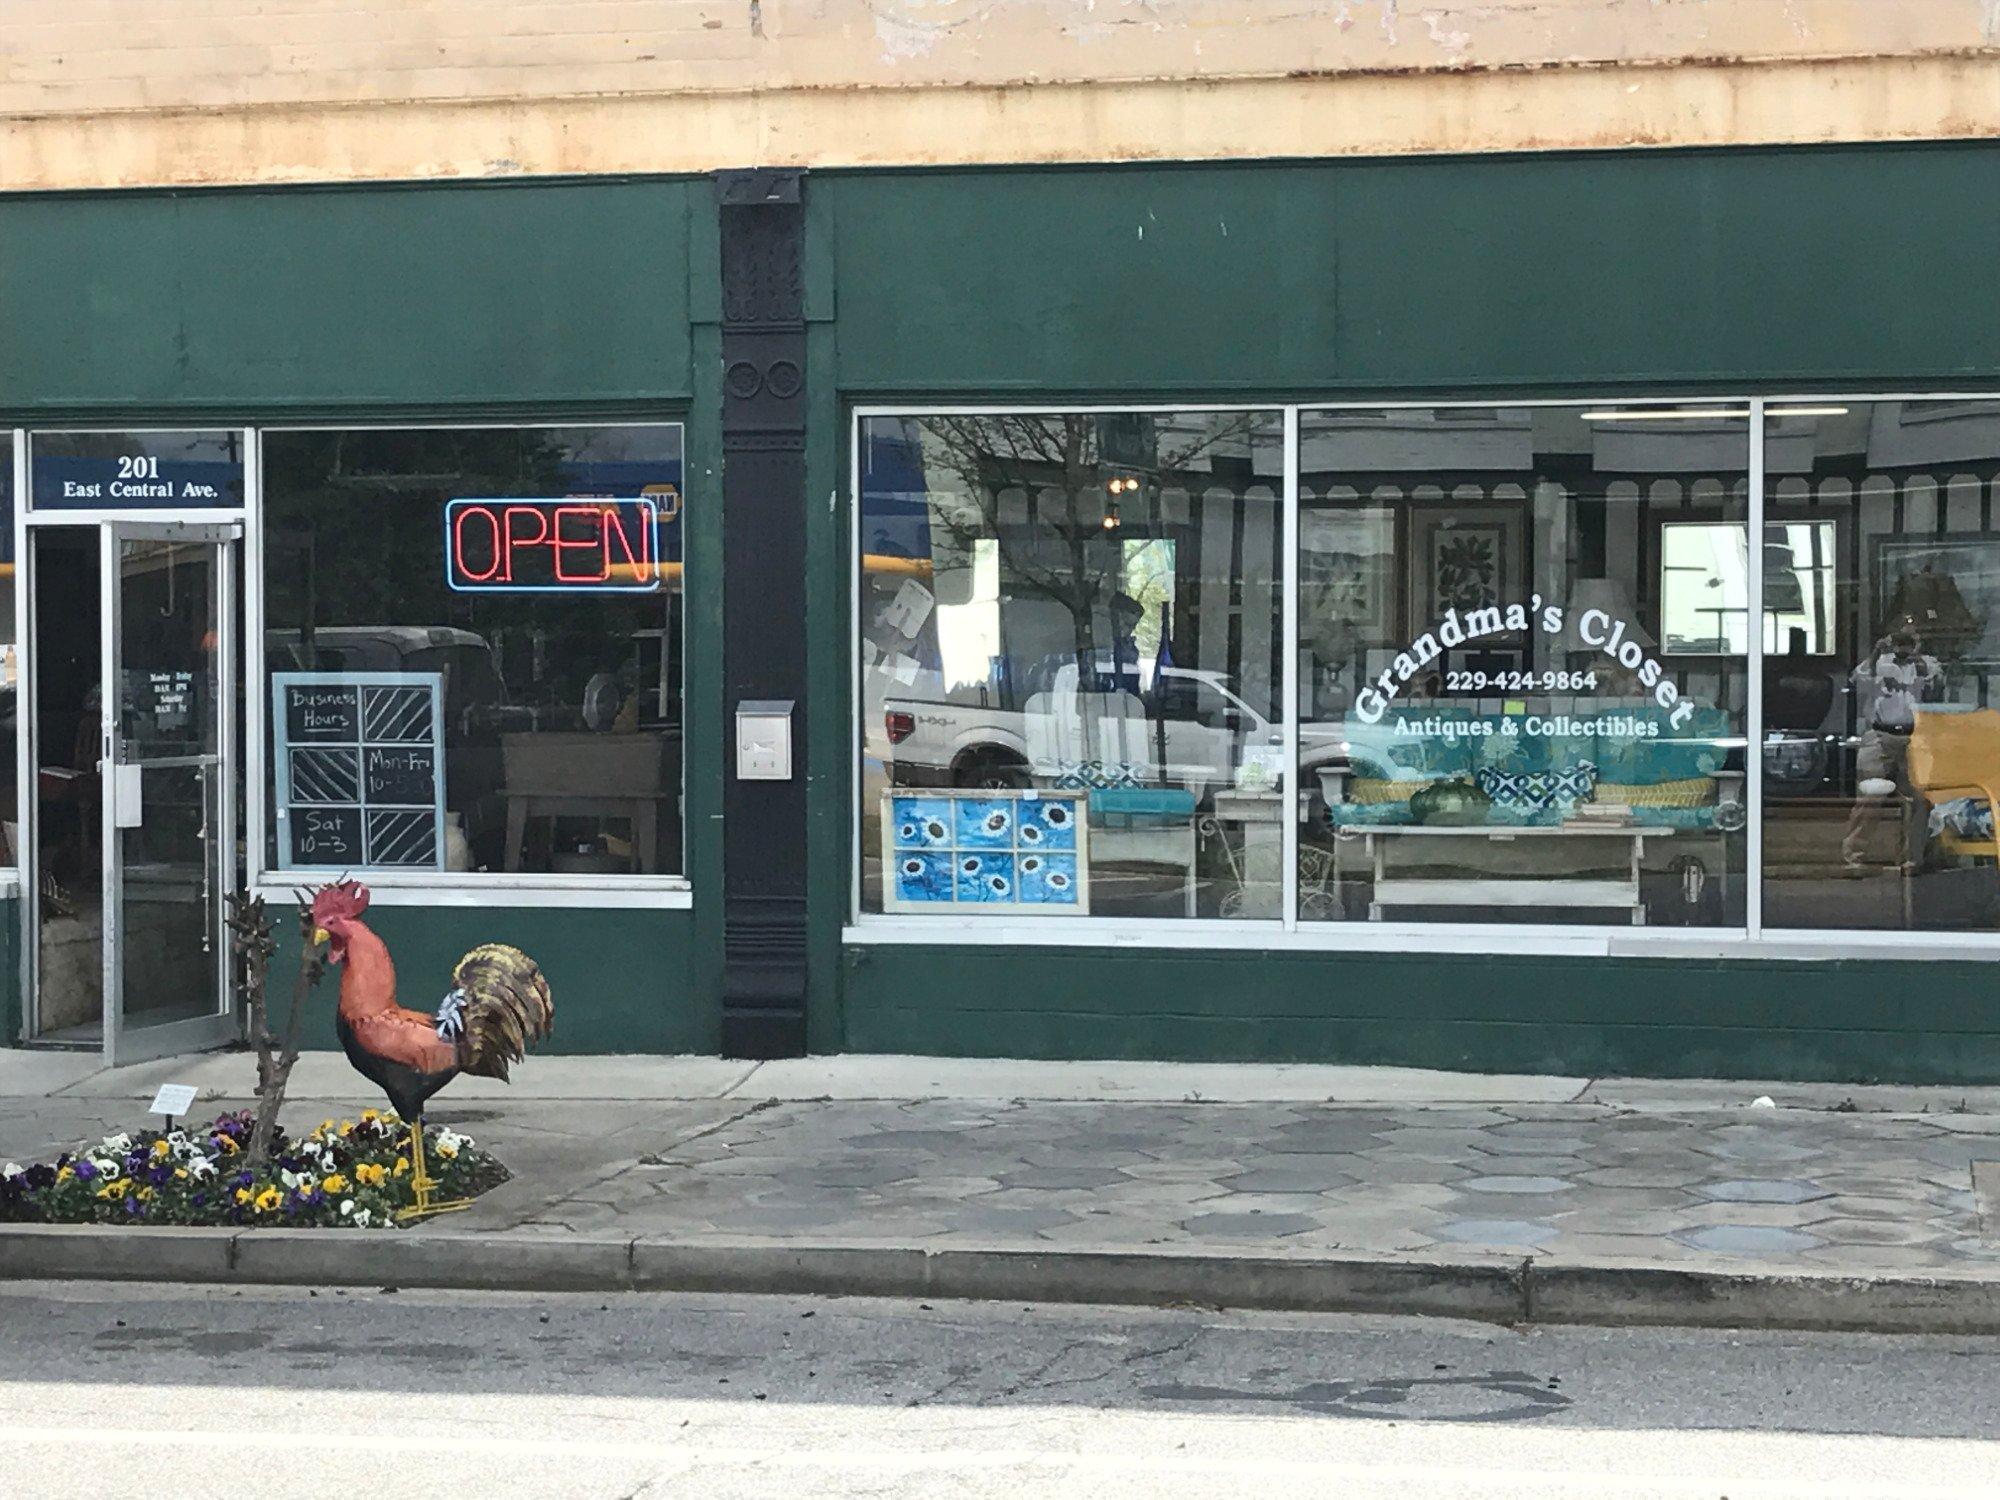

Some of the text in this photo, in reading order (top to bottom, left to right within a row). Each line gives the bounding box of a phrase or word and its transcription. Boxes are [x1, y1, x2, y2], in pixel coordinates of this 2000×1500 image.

[117, 456, 159, 479] 201
[63, 481, 219, 497] East Central Ave.
[455, 506, 649, 582] OPEN
[1355, 593, 1696, 731] Grandma's Closet
[1446, 670, 1598, 691] 229-424-9864
[291, 688, 356, 707] Business
[303, 710, 350, 728] Hours
[1393, 716, 1659, 738] Antiques & Collectibles
[305, 810, 344, 832] Sat
[301, 836, 348, 853] 10-3
